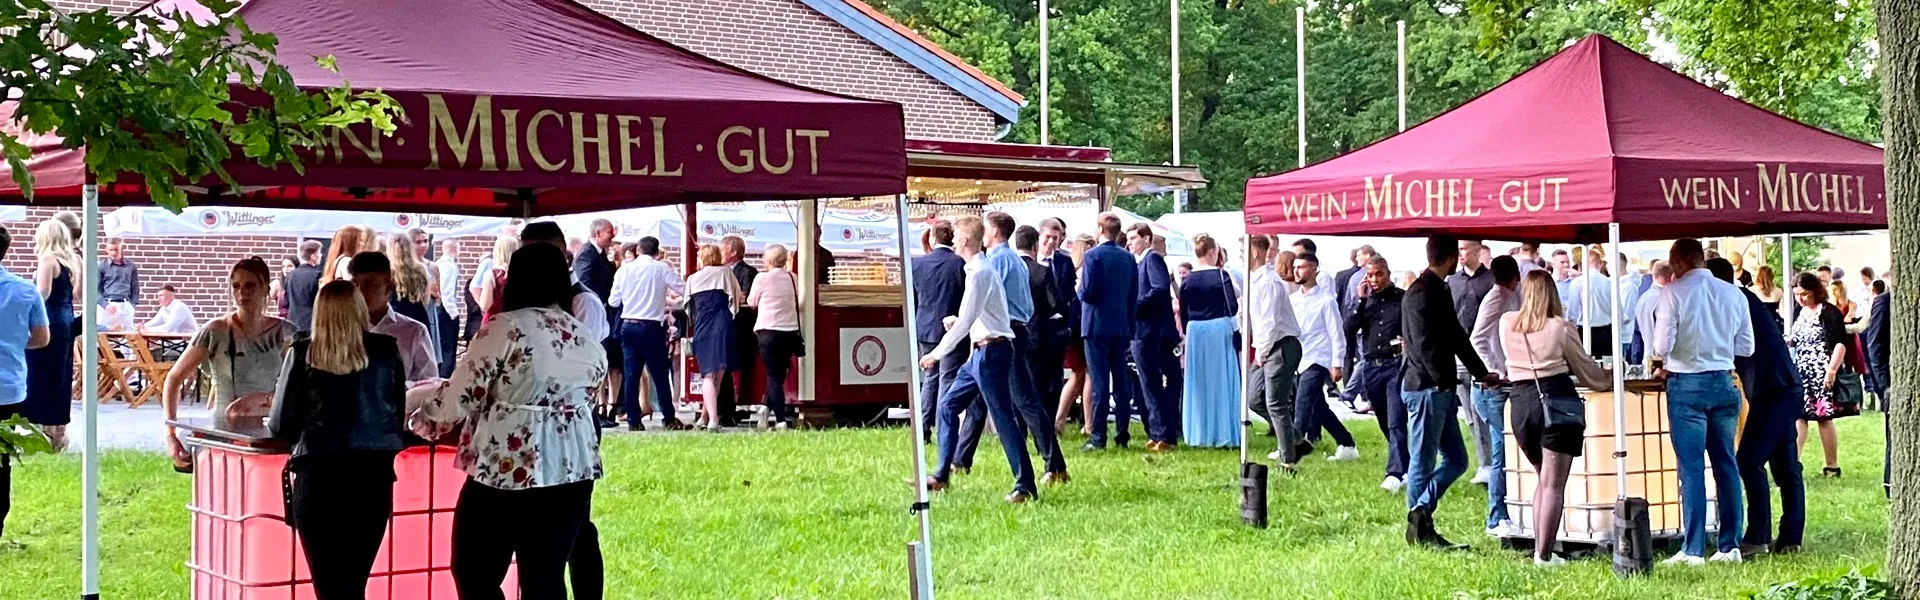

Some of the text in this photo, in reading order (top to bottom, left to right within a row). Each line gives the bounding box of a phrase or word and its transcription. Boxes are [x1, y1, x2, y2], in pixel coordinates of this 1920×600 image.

[422, 92, 684, 177] MICHEL
[716, 125, 830, 175] GUT
[1280, 173, 1569, 223] WEIN MICHEL GUT
[1659, 162, 1874, 215] WEIN MICHEL
[221, 210, 275, 227] Wittinger
